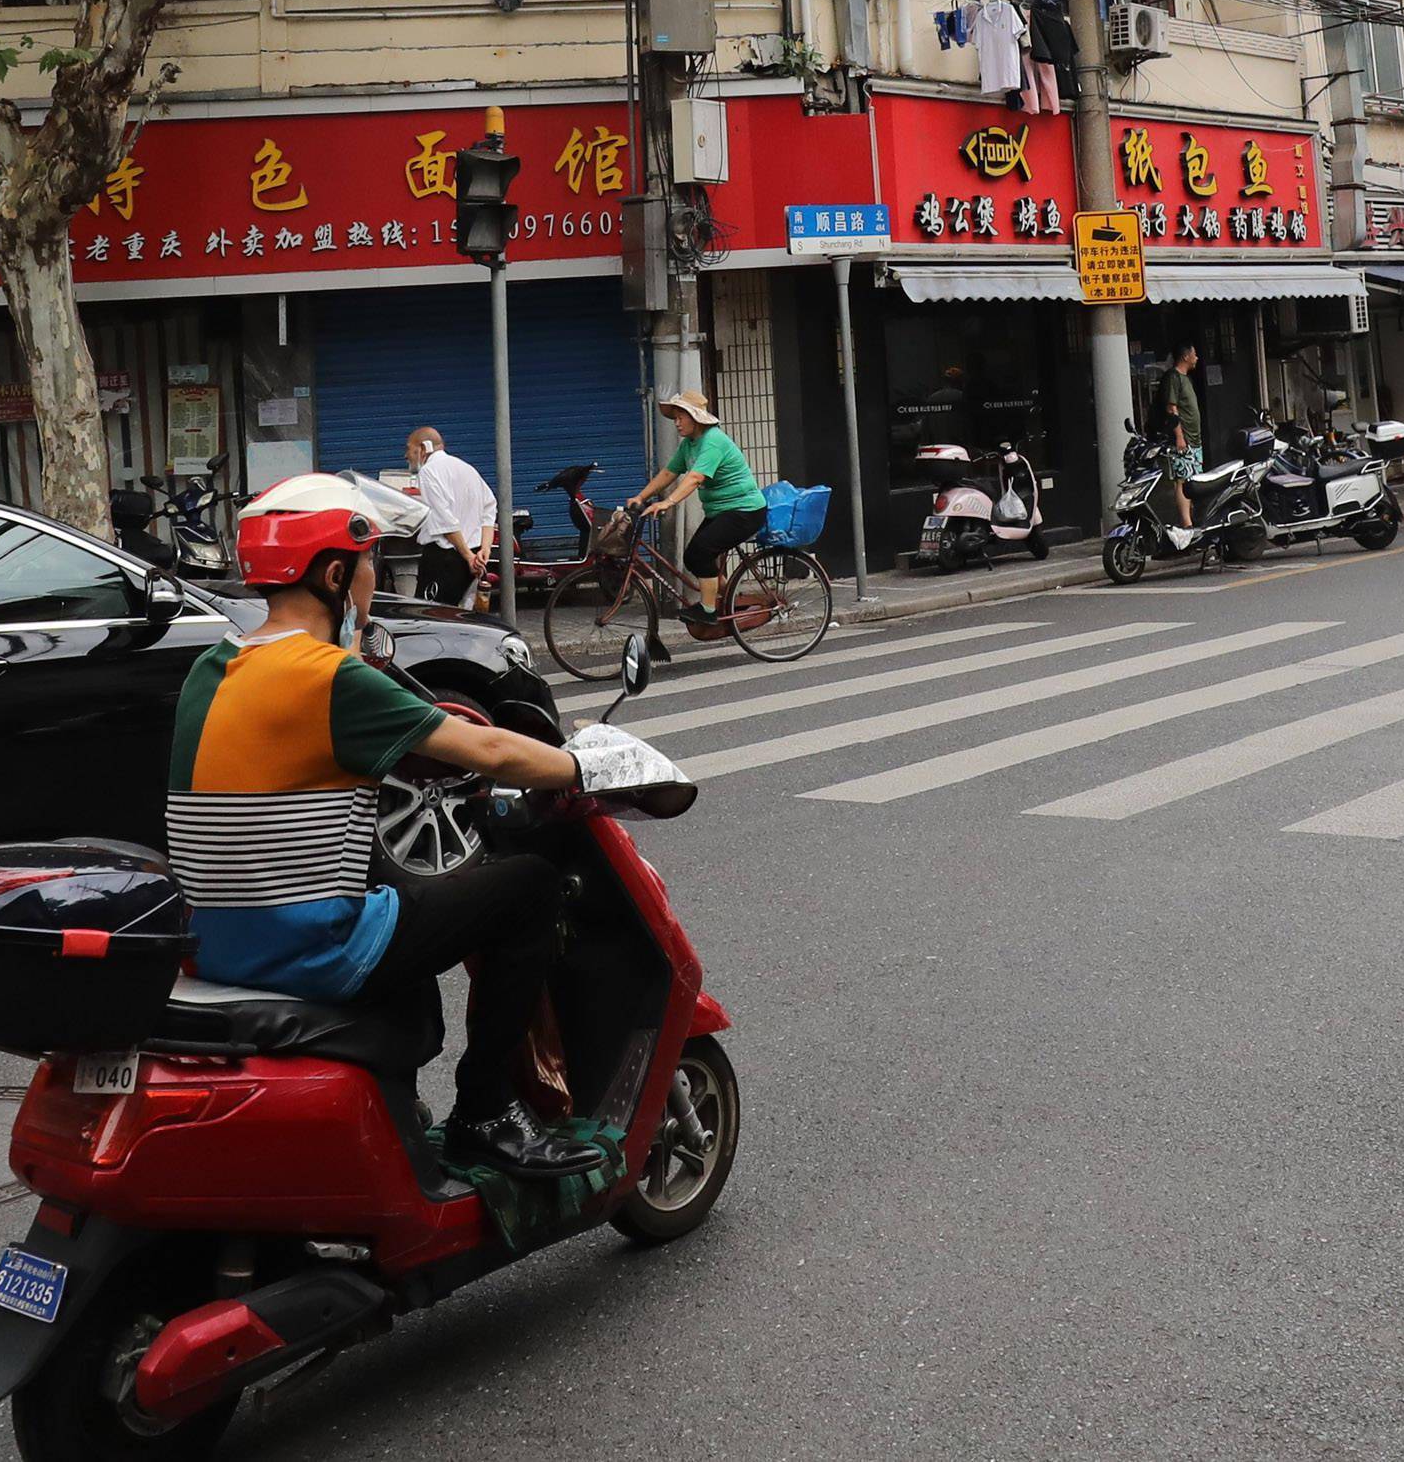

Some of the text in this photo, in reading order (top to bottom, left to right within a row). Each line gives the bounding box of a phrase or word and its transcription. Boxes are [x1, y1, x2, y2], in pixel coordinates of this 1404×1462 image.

[1127, 128, 1274, 196] 纸包鱼
[794, 210, 885, 232] 南 顺昌路 北
[919, 193, 998, 237] 鸡公煲
[1018, 196, 1065, 236] 烤鱼
[1181, 205, 1221, 240] 火锅
[819, 240, 853, 250] Shunchang
[1080, 244, 1139, 257] 停车行为违法
[1087, 259, 1136, 270] 请立即驶离
[1082, 272, 1140, 285] 电子警察监管
[96, 1066, 132, 1089] 040
